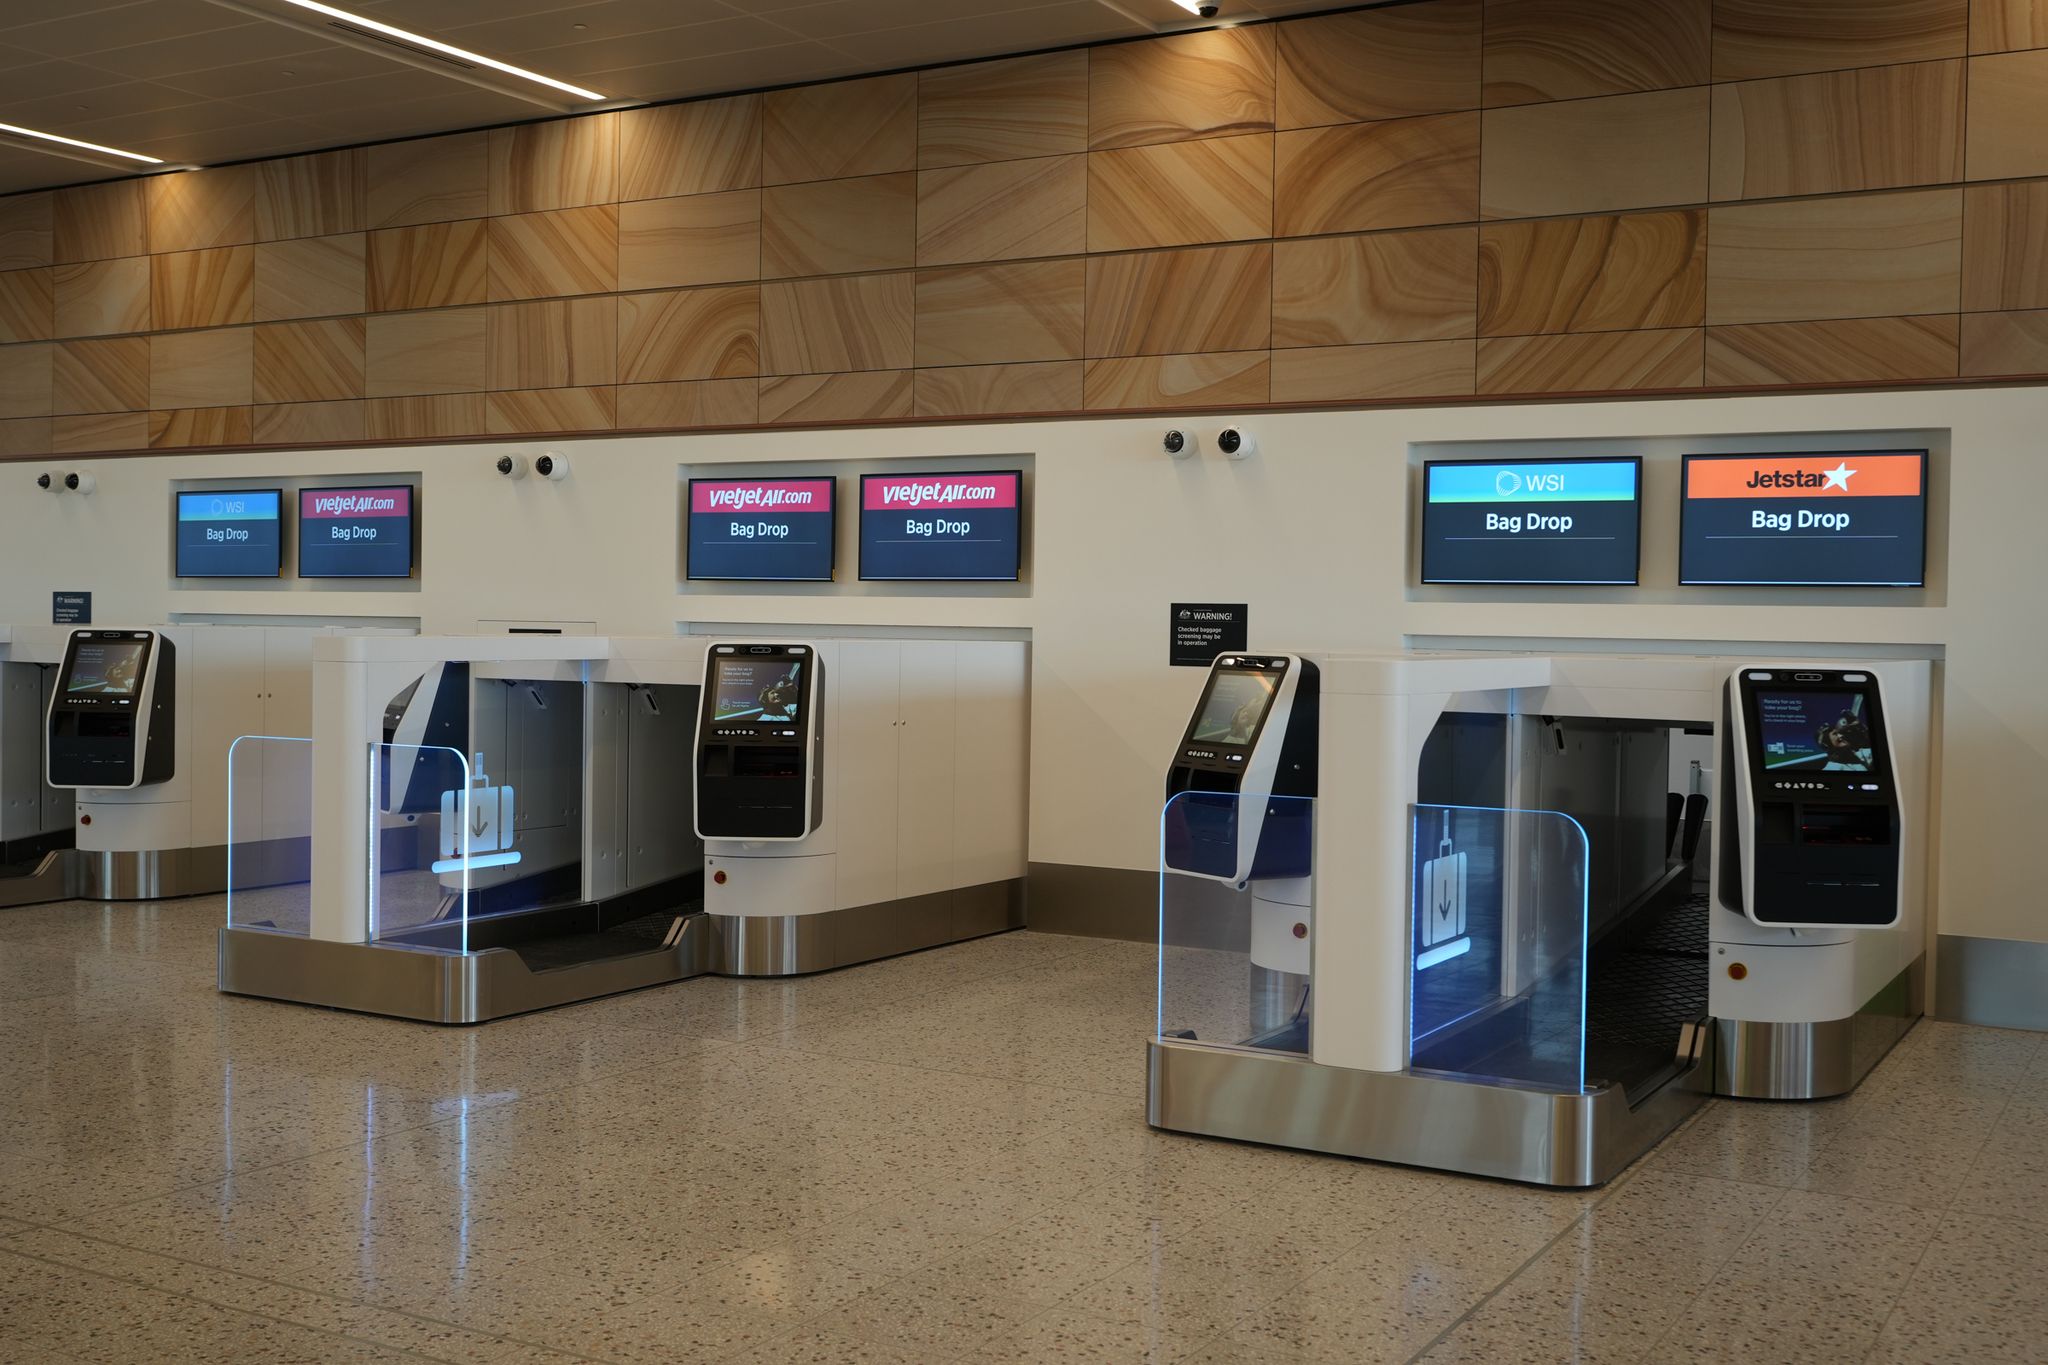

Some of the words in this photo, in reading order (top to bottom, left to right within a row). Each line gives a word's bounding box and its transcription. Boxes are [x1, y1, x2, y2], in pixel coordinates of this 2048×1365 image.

[1526, 474, 1564, 492] WSI
[1746, 469, 1826, 490] Jetstar
[226, 502, 245, 514] WSI
[906, 519, 932, 536] Bag
[936, 519, 970, 536] Drop
[1485, 512, 1522, 533] Bag
[1527, 512, 1573, 533] Drop
[1751, 509, 1792, 531] Bag
[1798, 509, 1850, 531] Drop
[206, 528, 224, 542] Bag
[226, 527, 249, 542] Drop
[331, 526, 351, 541] Bag
[353, 525, 377, 540] Drop
[730, 522, 755, 538] Bag
[758, 521, 789, 539] Drop
[1193, 612, 1233, 621] WARNING!
[1200, 626, 1222, 634] baggage
